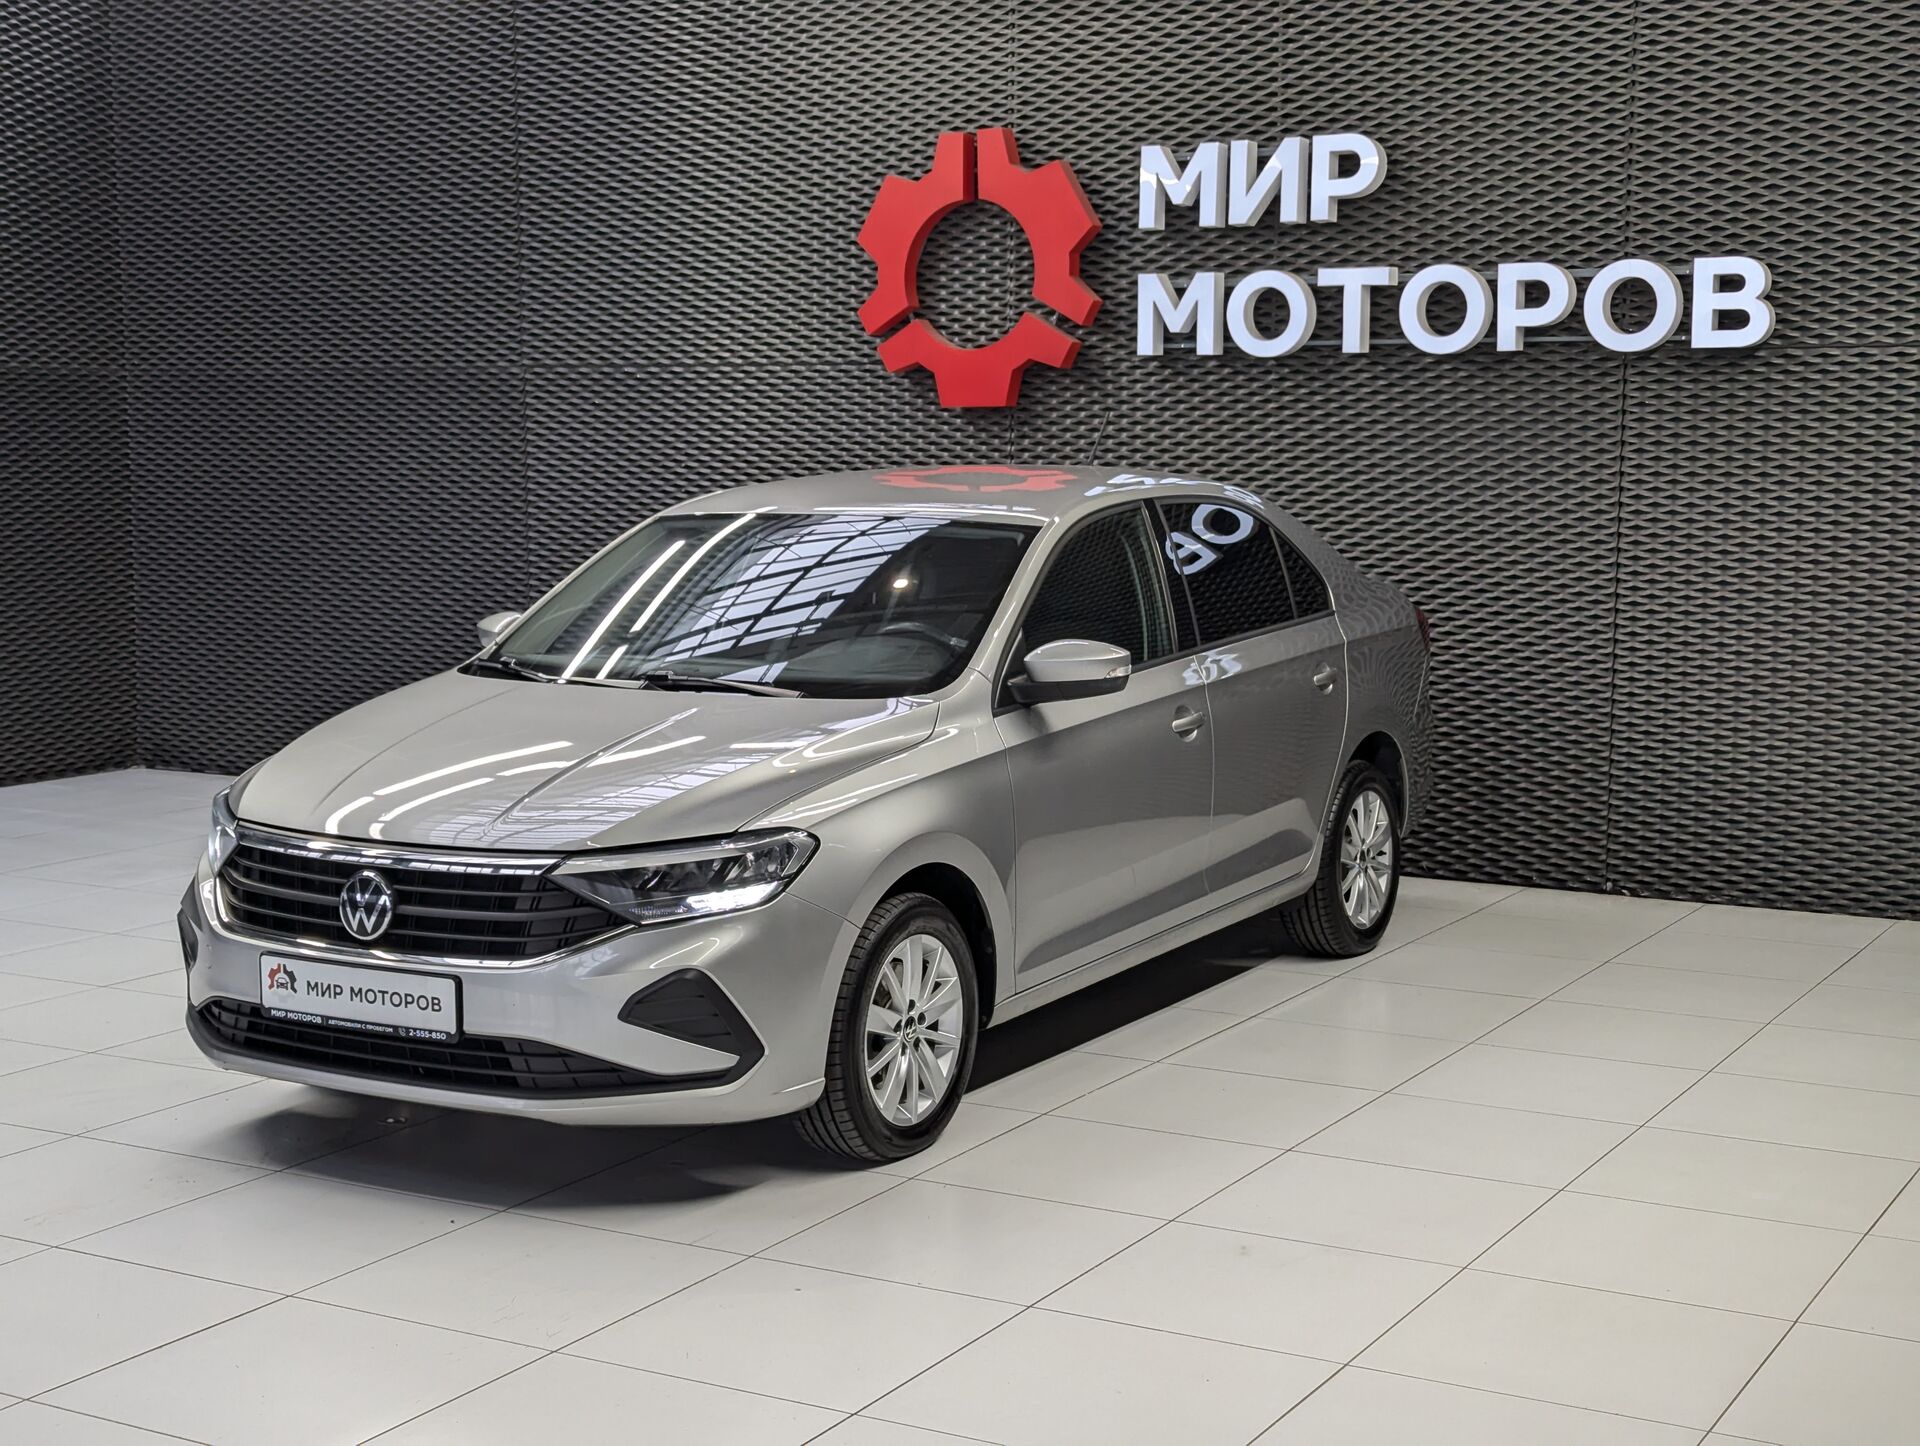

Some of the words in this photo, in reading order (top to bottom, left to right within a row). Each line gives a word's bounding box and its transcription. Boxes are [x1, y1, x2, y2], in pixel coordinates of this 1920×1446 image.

[1137, 133, 1387, 230] МИР
[1136, 255, 1776, 358] МОТОРОВ
[270, 1008, 286, 1018] МИР
[287, 1011, 322, 1024] МОТОРОВ
[408, 1028, 447, 1040] 2-555-850
[306, 980, 344, 1000] МИР
[349, 986, 442, 1012] МОТОРОВ
